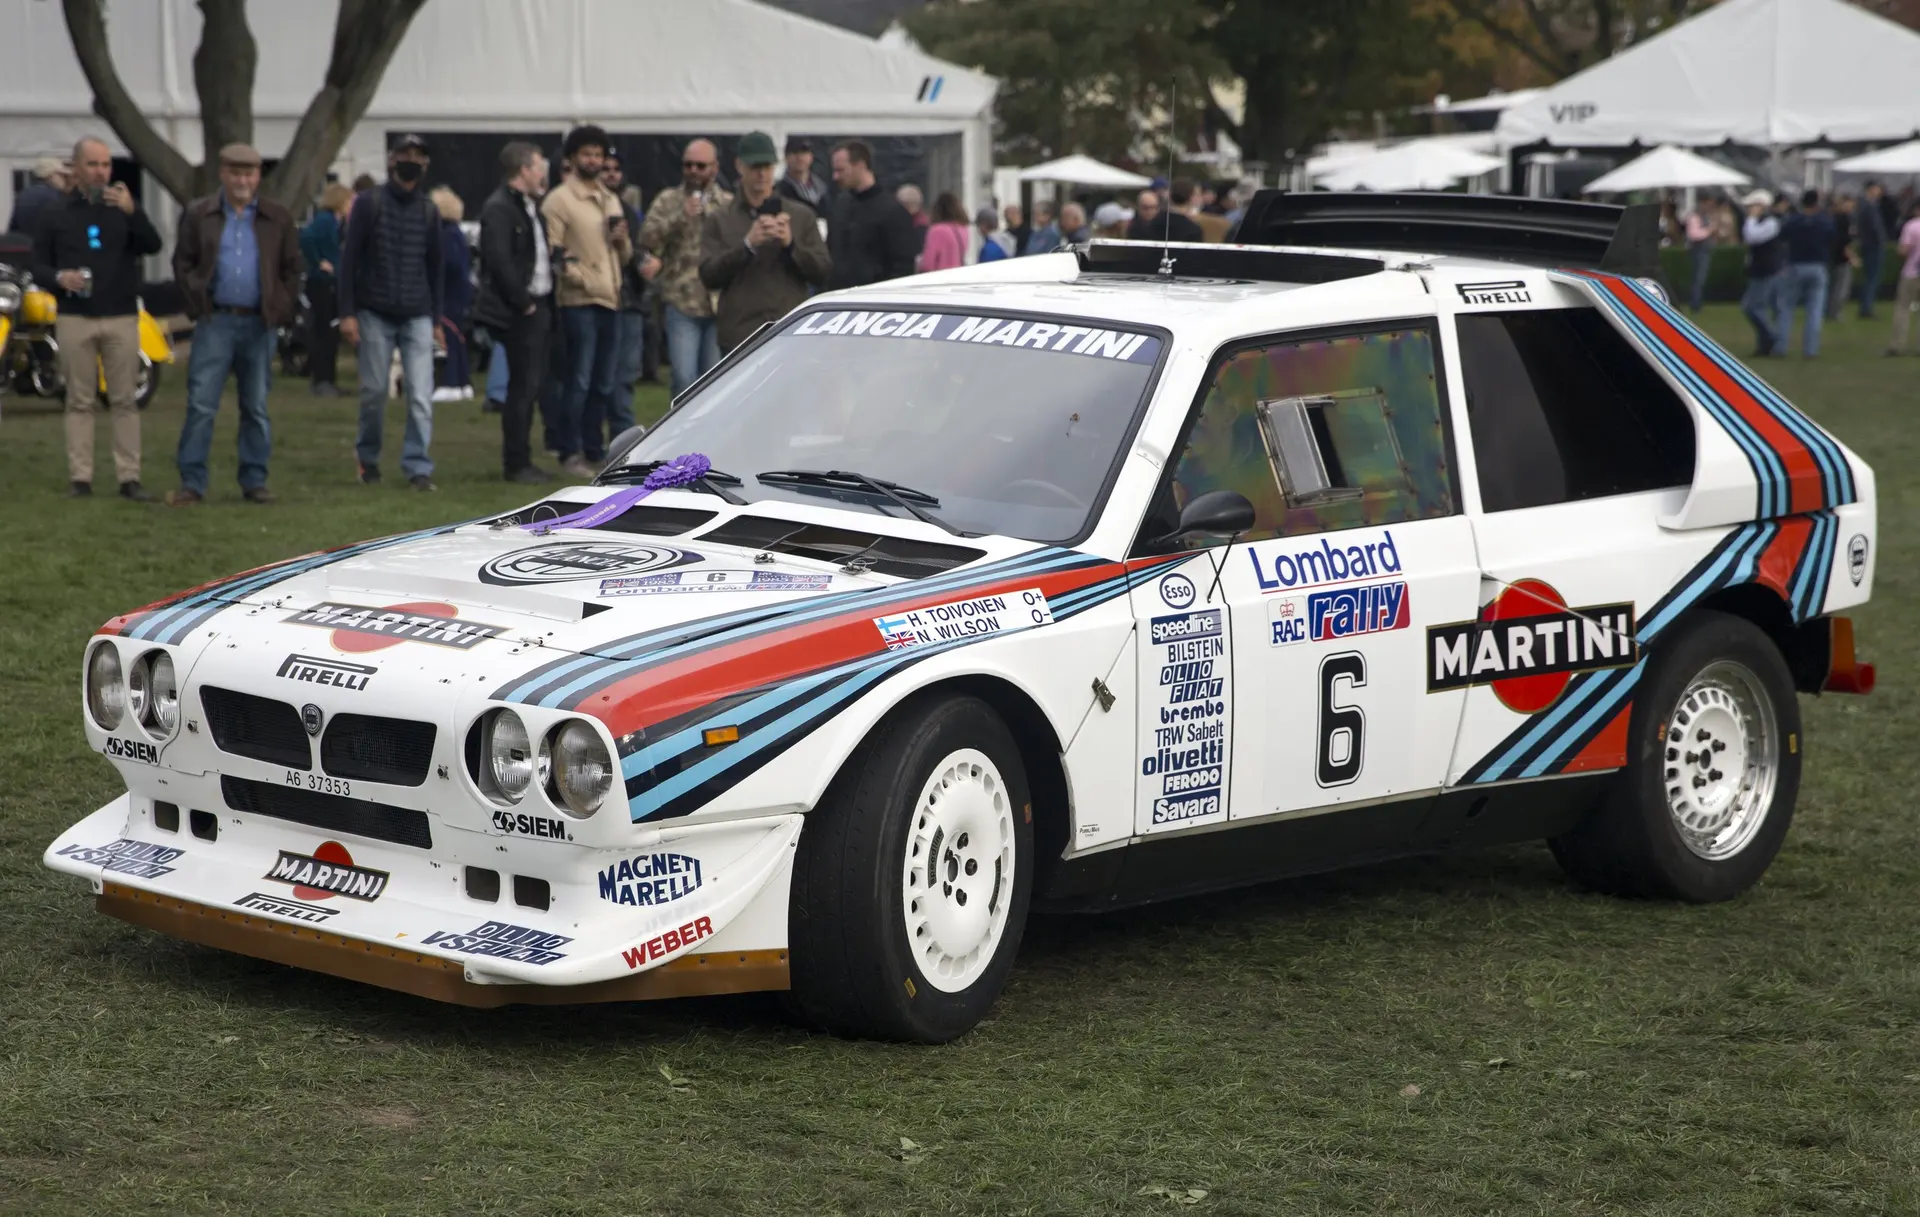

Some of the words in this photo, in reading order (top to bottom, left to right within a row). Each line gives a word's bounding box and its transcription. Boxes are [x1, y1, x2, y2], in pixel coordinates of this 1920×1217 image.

[1548, 103, 1597, 124] VIP
[1455, 281, 1532, 304] PIRELLI
[793, 311, 942, 339] LANCIA
[946, 318, 1149, 361] MARTINI
[1247, 530, 1402, 590] Lombard
[601, 585, 713, 596] Lombard
[707, 573, 727, 582] 6
[298, 605, 494, 645] MARTINI
[907, 613, 928, 628] H.
[928, 596, 1007, 622] TOIVONEN
[1272, 617, 1305, 644] RAC
[1312, 582, 1406, 641] rally
[918, 629, 937, 644] N.
[938, 616, 1001, 641] WILSON
[1152, 614, 1214, 642] speedline
[1168, 637, 1224, 663] BILSTEIN
[1435, 612, 1630, 681] MARTINI
[275, 653, 379, 691] PIRELLI
[1161, 660, 1213, 685] OLIO
[1171, 678, 1223, 703] FIAT
[1160, 700, 1225, 724] brembo
[1315, 650, 1367, 789] 6
[1155, 725, 1185, 748] TRW
[1187, 719, 1224, 743] Sabelt
[124, 739, 159, 764] SIEM
[1142, 738, 1224, 776] olivetti
[285, 770, 301, 786] A6
[308, 774, 351, 797] 37353
[1164, 767, 1220, 793] FERODO
[1154, 795, 1218, 823] Savara
[516, 814, 566, 840] SIEM
[271, 856, 384, 899] MARTINI
[598, 853, 702, 888] MAGNETI
[598, 875, 703, 906] MARELLI
[232, 891, 341, 923] PIRELLI
[472, 922, 569, 949] OLIO
[621, 915, 715, 970] WEBER
[465, 941, 563, 963] FIAT
